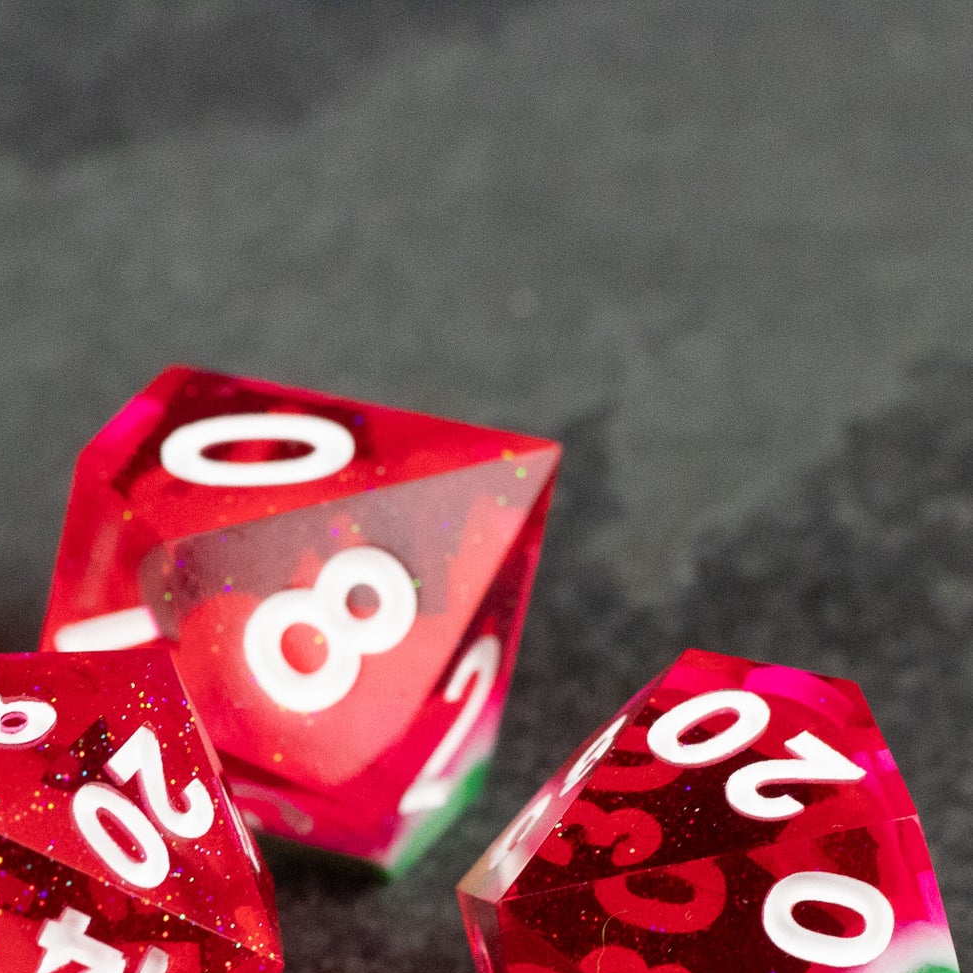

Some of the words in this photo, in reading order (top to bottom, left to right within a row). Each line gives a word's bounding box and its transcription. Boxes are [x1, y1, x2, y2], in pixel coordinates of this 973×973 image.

[160, 412, 356, 487] 0
[243, 546, 417, 713] 8
[72, 721, 217, 890] 20
[398, 634, 502, 814] 2
[647, 689, 866, 821] 20
